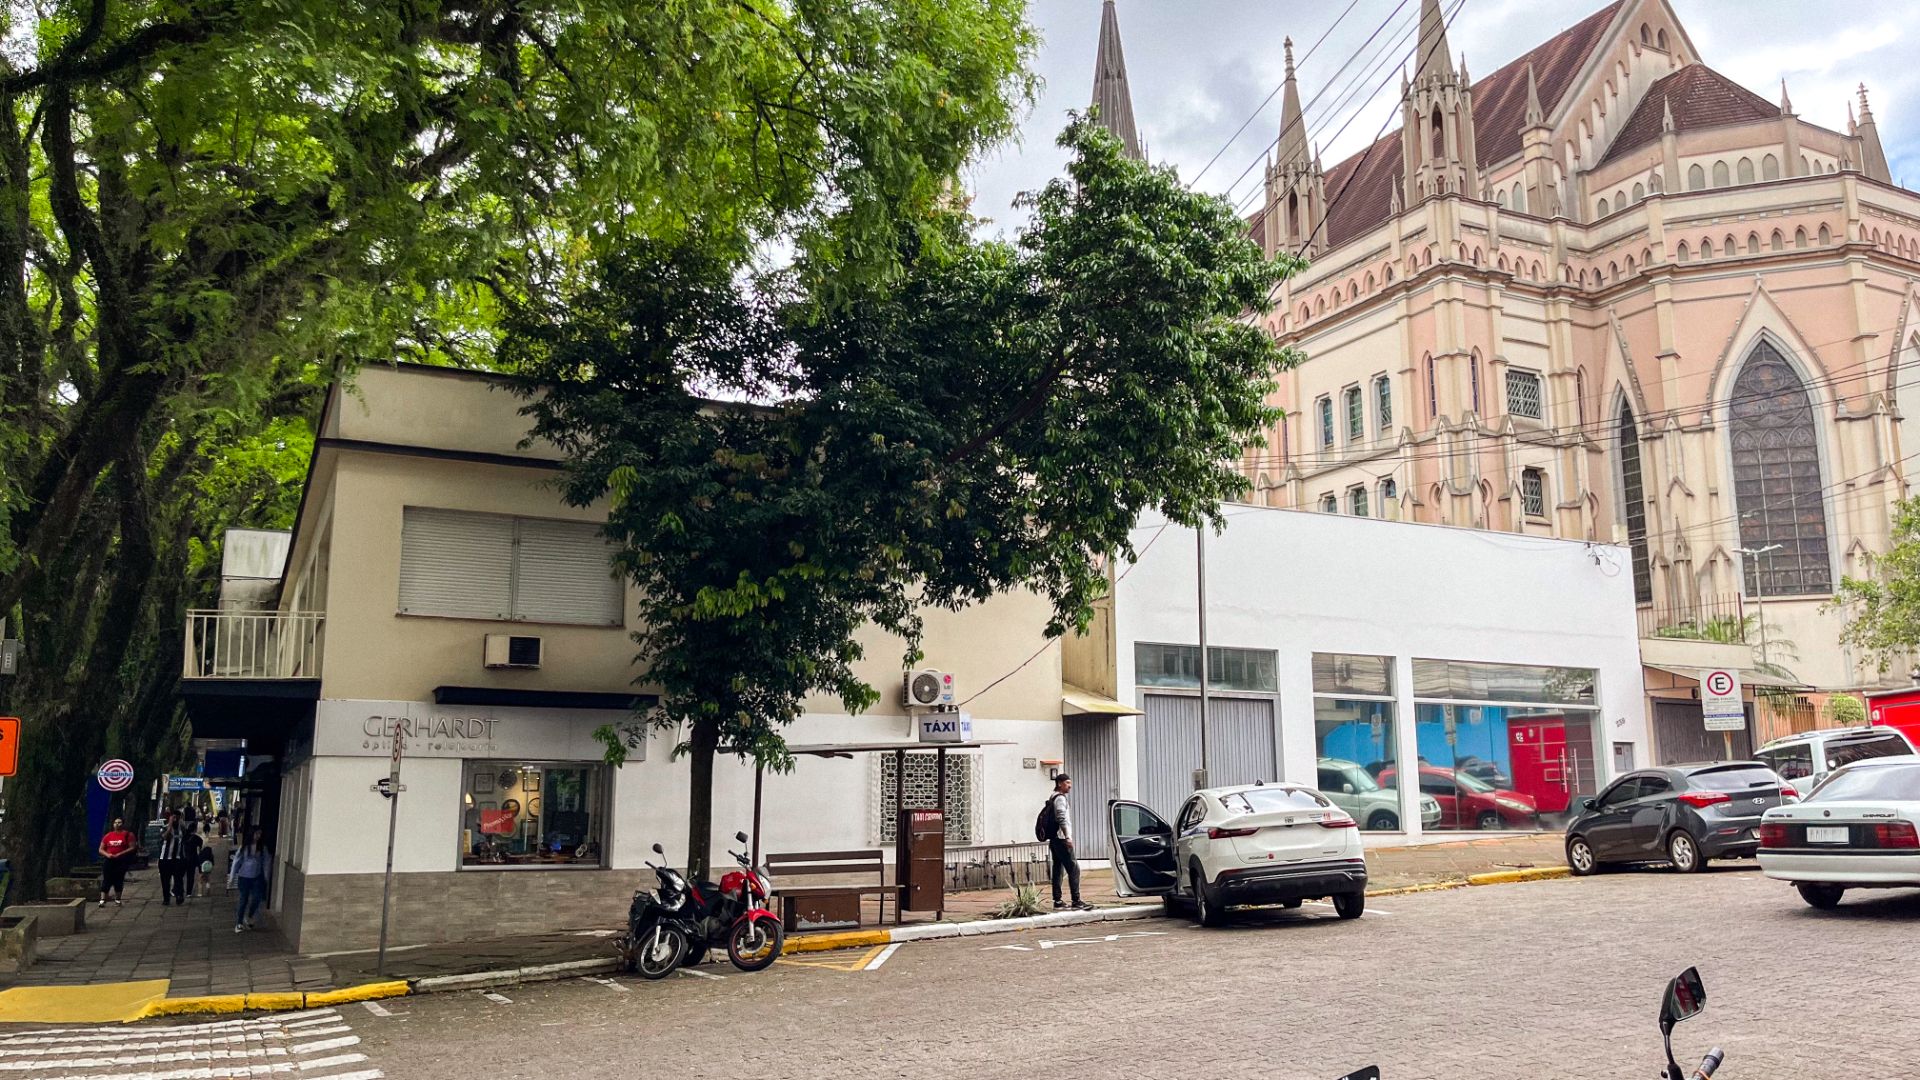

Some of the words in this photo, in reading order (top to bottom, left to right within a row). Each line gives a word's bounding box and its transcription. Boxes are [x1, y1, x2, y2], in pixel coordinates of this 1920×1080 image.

[1715, 677, 1726, 690] E
[363, 716, 500, 739] GERHARDT
[924, 720, 955, 732] TÁXI
[362, 740, 408, 751] óptia
